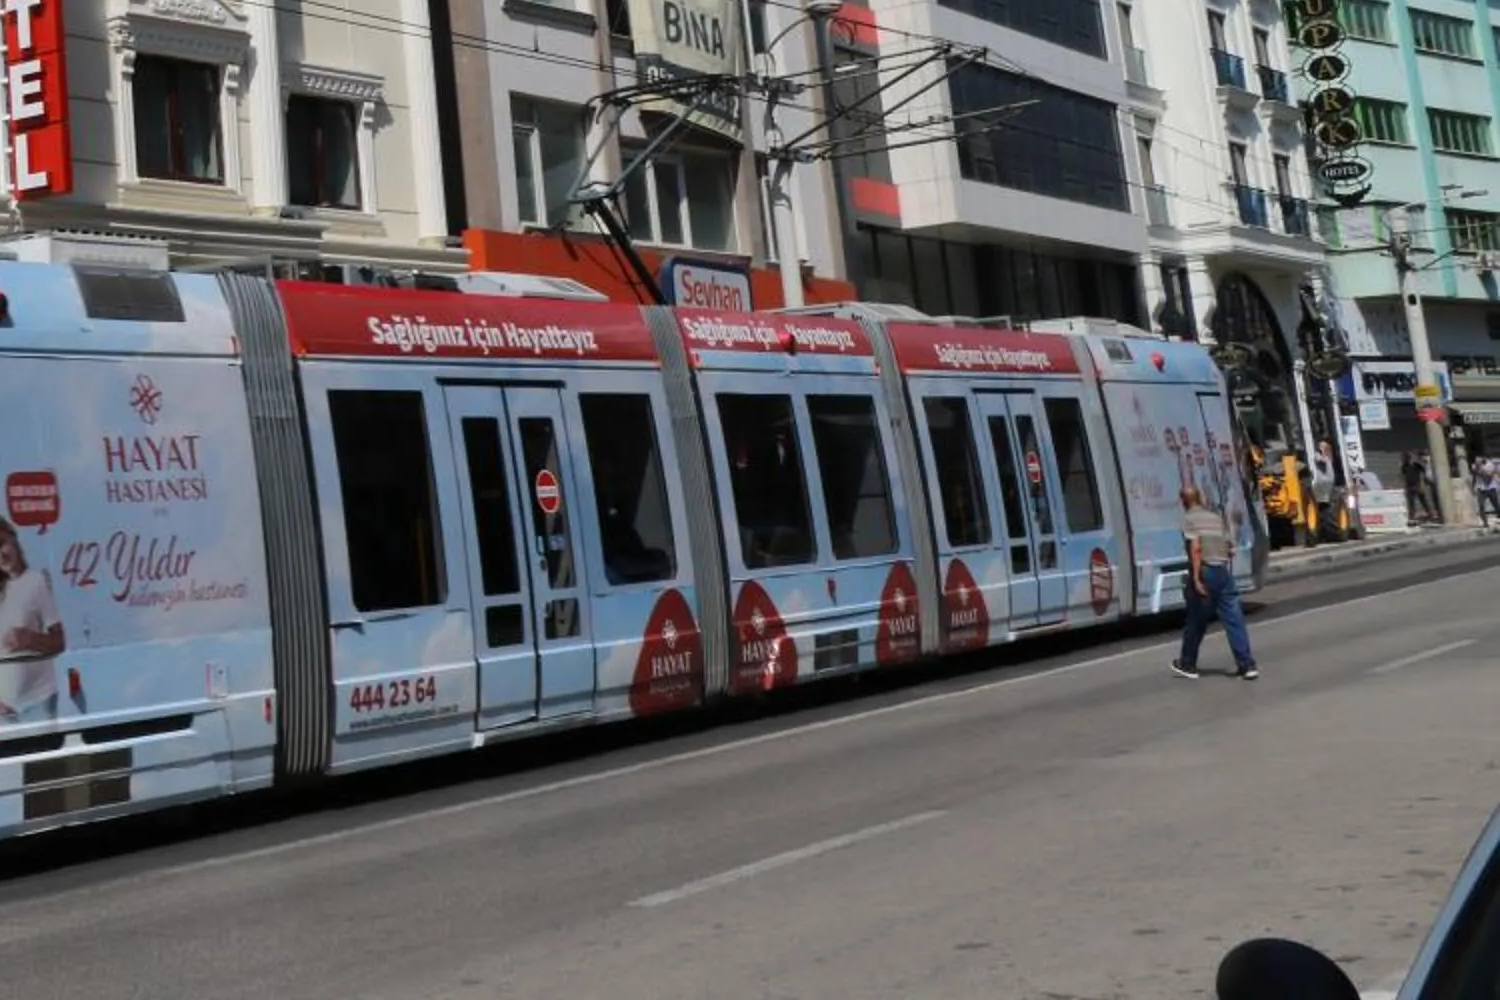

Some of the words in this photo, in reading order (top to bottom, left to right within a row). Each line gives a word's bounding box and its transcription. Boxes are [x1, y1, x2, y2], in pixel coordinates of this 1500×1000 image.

[664, 0, 726, 60] BİNA
[1325, 166, 1359, 177] HOTEL
[367, 315, 468, 352] Sağlığınız
[464, 318, 504, 355] için
[503, 322, 598, 355] Hayattayız
[103, 434, 200, 472] HAYAT
[106, 474, 208, 503] HASTANESİ
[62, 541, 100, 588] 42
[106, 530, 196, 602] Yıldır
[652, 651, 692, 677] HAYAT
[350, 683, 384, 712] 444
[389, 680, 410, 707] 23
[415, 676, 436, 703] 64
